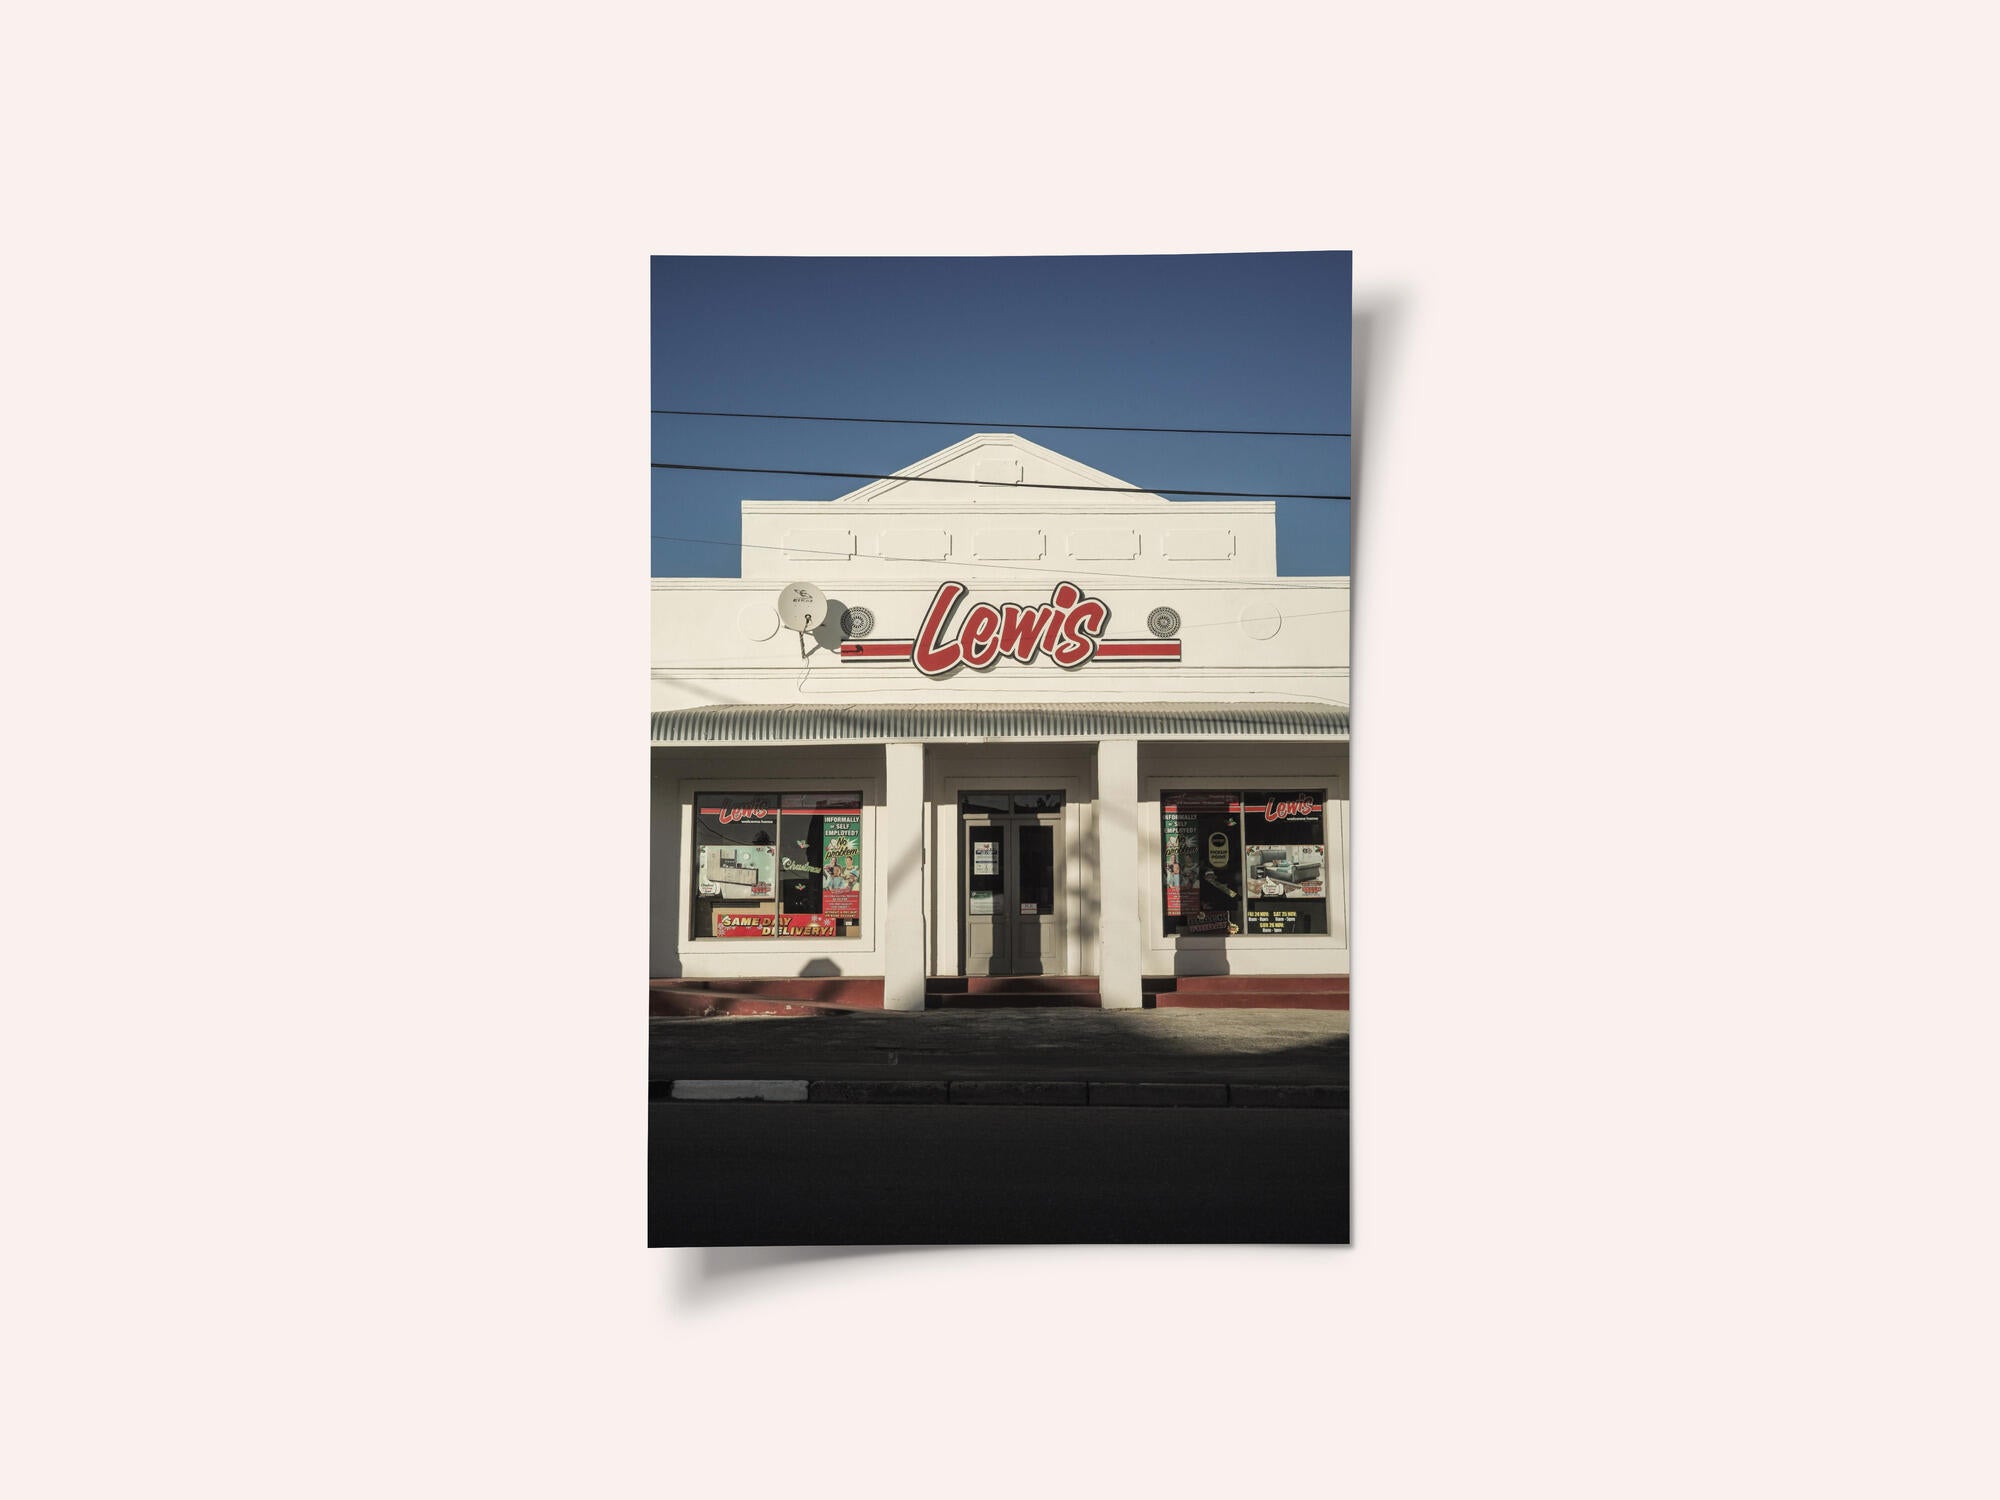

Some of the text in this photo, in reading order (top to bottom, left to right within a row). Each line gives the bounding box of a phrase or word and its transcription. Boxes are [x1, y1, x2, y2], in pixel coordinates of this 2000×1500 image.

[912, 581, 1112, 679] Lewis
[719, 799, 767, 824] Lewis
[1265, 794, 1313, 822] Lewis
[723, 917, 791, 926] SAME DAY
[762, 926, 834, 936] DELIVERY!
